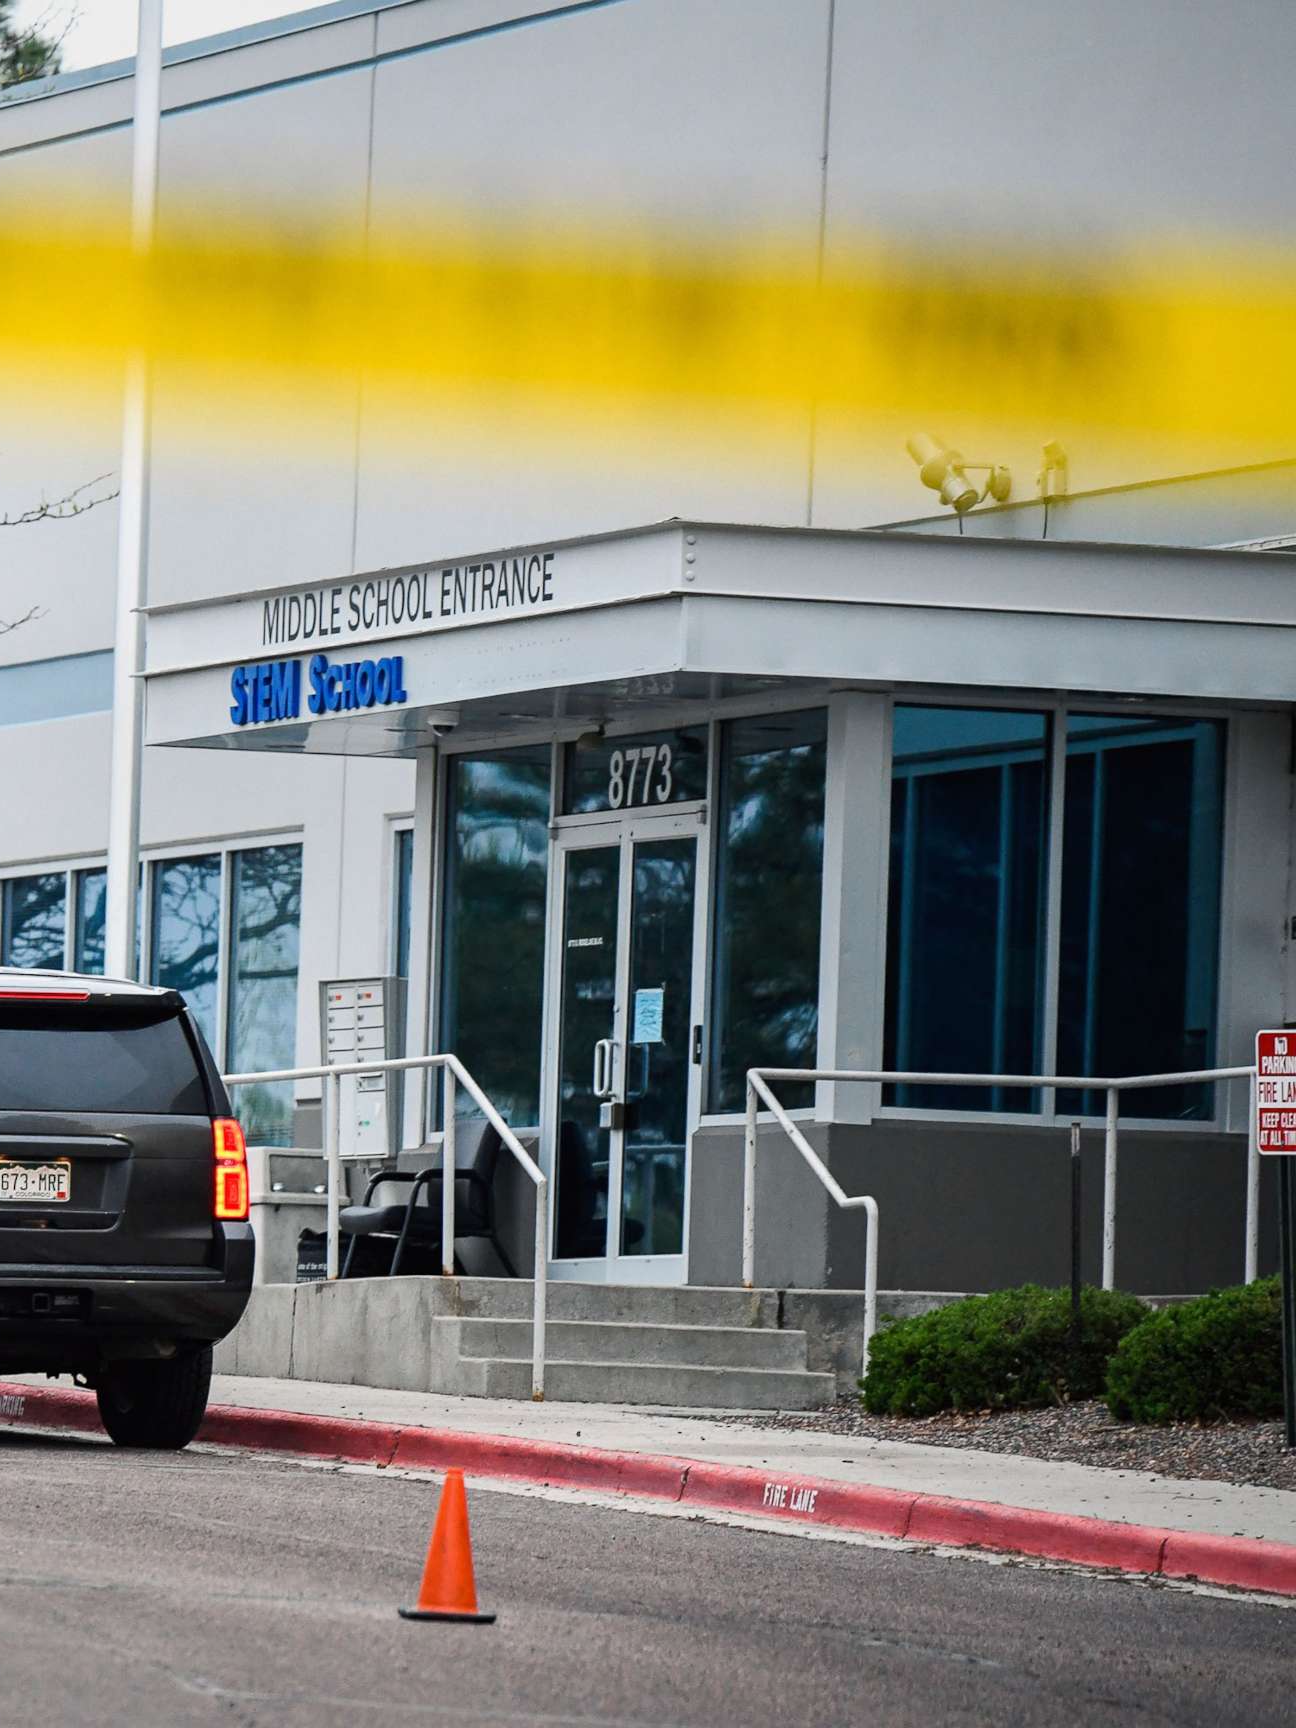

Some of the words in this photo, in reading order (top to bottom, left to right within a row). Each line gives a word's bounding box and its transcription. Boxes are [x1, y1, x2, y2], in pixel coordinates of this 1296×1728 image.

[263, 587, 342, 645] MIDDLE
[348, 573, 432, 631] SCHOOL
[440, 553, 554, 617] ENTRANCE
[230, 659, 301, 726] STEM
[608, 744, 672, 808] 8773
[1274, 1037, 1288, 1055] NO
[1261, 1056, 1296, 1074] PARKIN
[1259, 1082, 1277, 1102] FIRE
[1282, 1082, 1296, 1102] LA
[1261, 1112, 1280, 1128] KEEP
[1281, 1112, 1296, 1128] CLE
[1260, 1130, 1269, 1145] AT
[763, 1482, 788, 1508] FIRE
[789, 1487, 818, 1513] LANE
